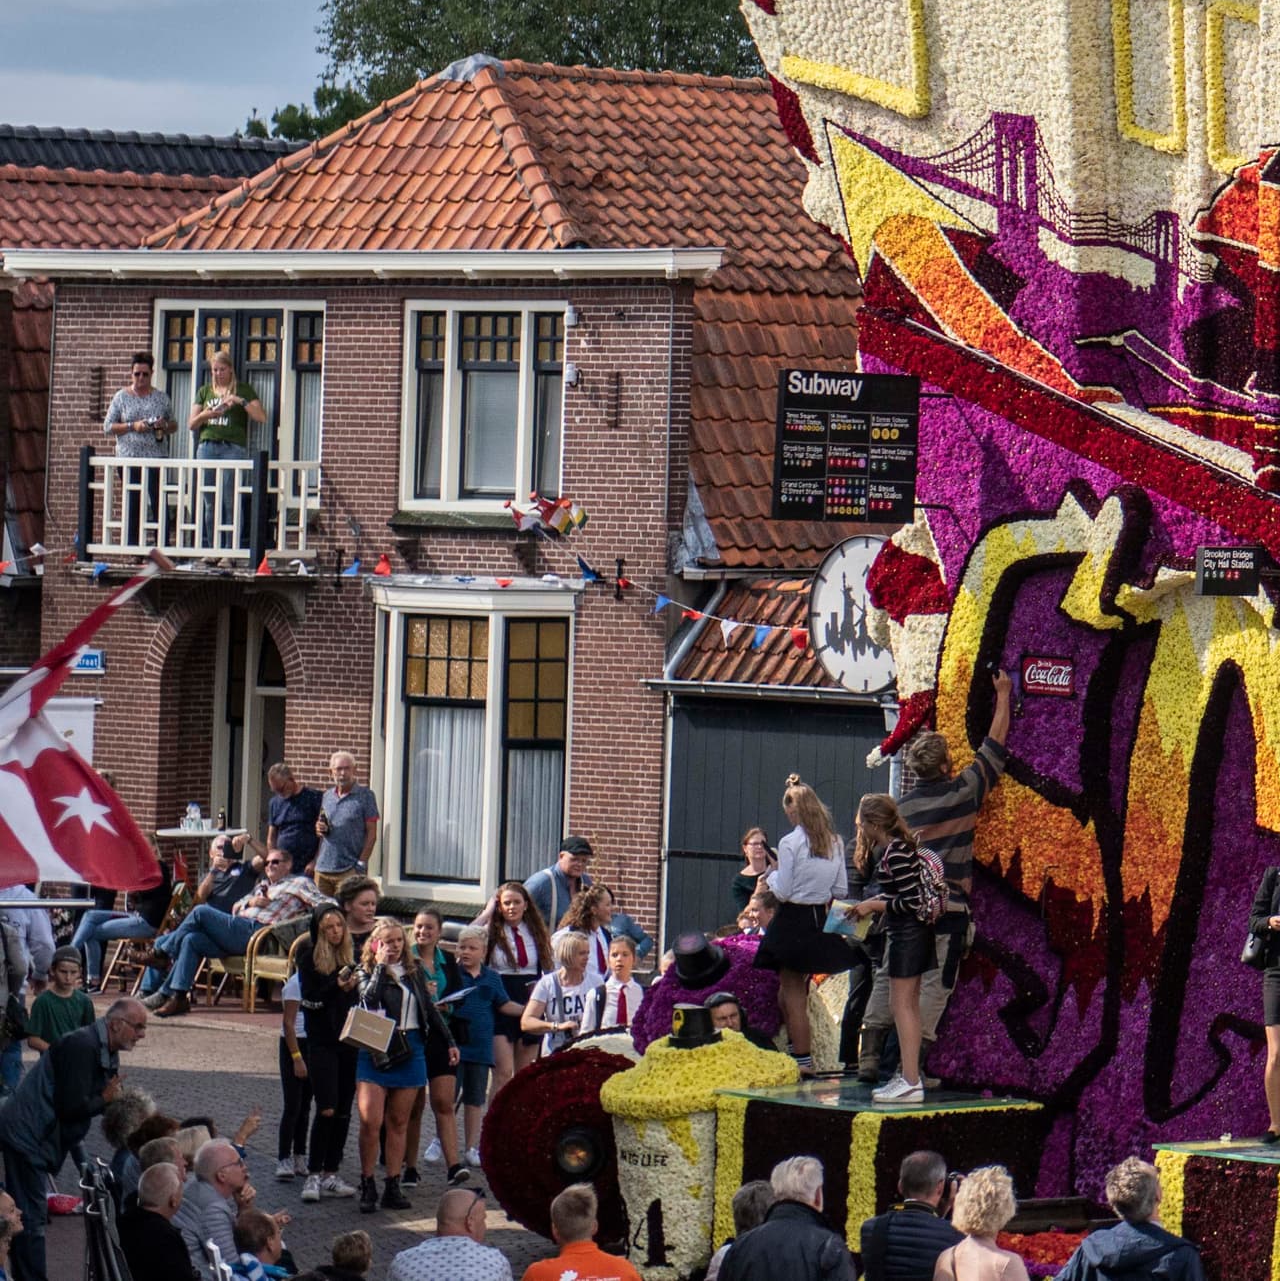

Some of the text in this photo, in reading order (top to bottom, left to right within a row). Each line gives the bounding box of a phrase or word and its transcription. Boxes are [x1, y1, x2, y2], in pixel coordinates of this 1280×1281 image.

[788, 371, 863, 401] Subway
[1204, 549, 1254, 560] Brooklyn Bridge
[1204, 559, 1254, 570] City Hall Station
